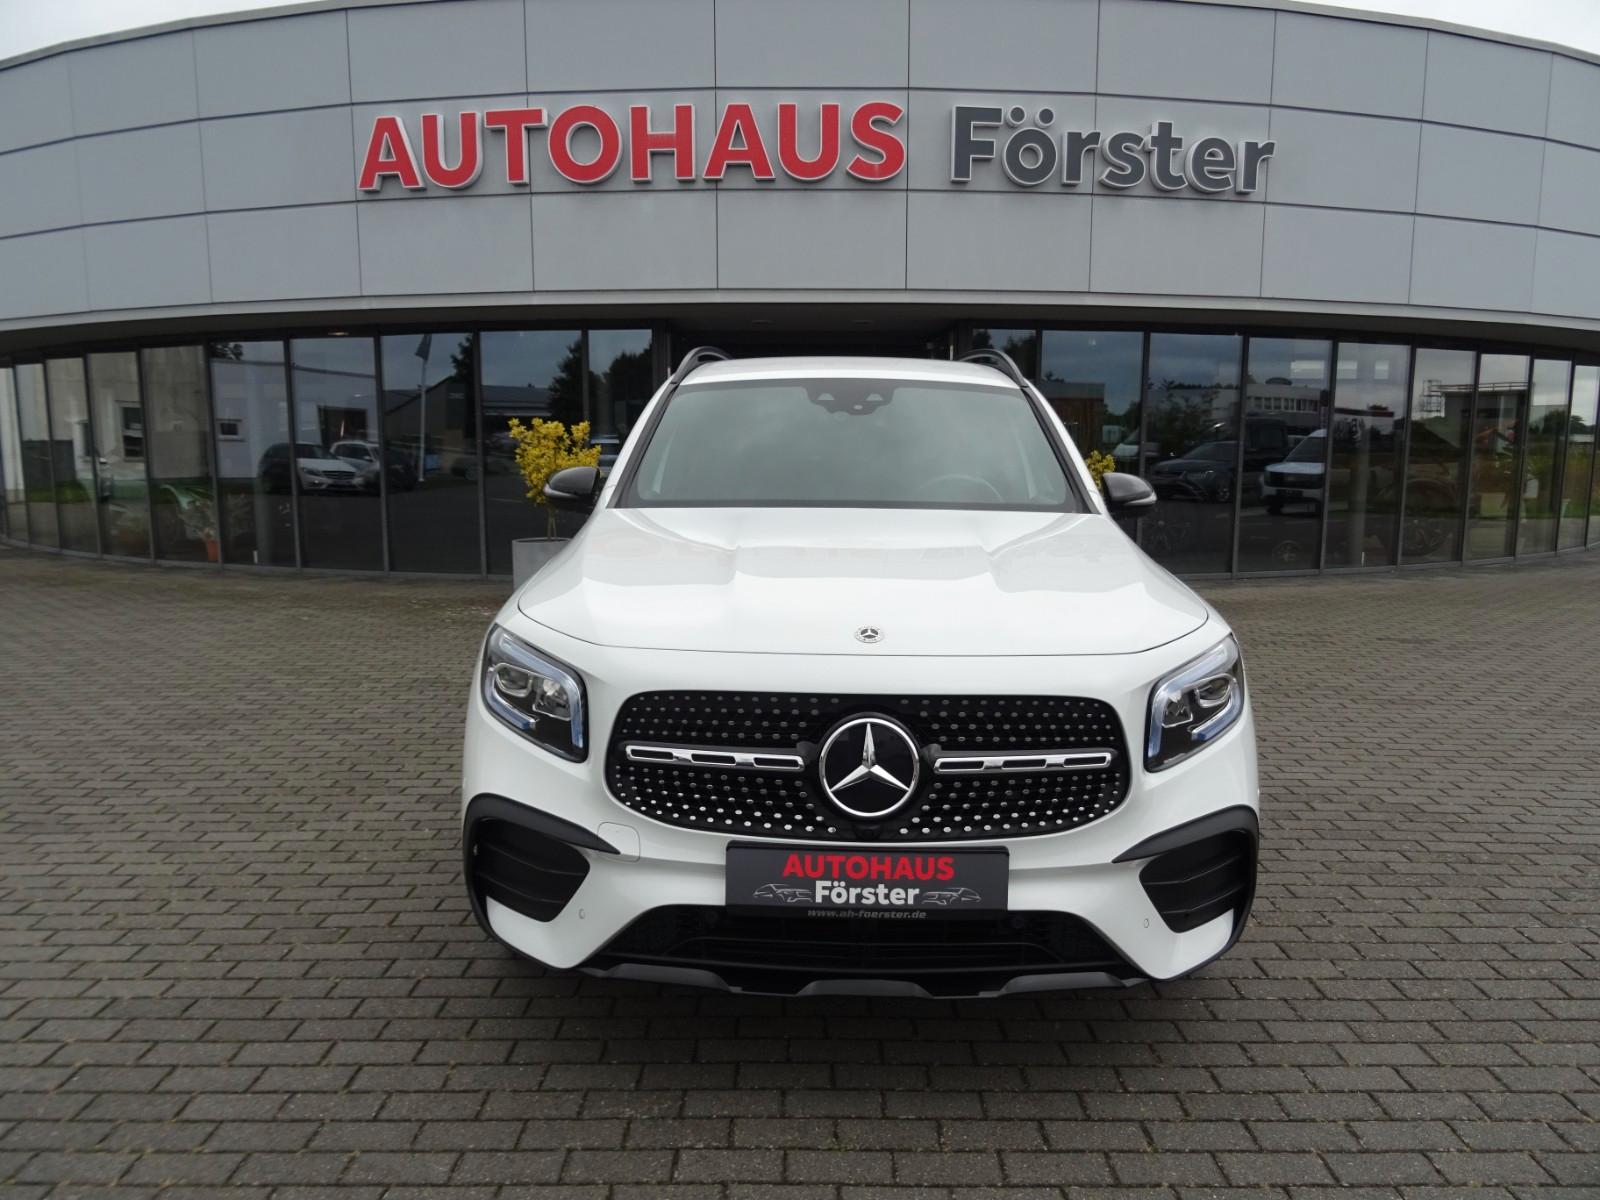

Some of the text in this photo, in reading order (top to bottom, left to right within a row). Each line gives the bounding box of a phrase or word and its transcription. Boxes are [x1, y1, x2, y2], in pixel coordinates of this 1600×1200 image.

[356, 103, 1275, 194] AUTOHAUS Förster
[782, 853, 955, 881] AUTOHAUS
[814, 880, 920, 906] Förster
[807, 909, 927, 919] www.ah-foerster.de
